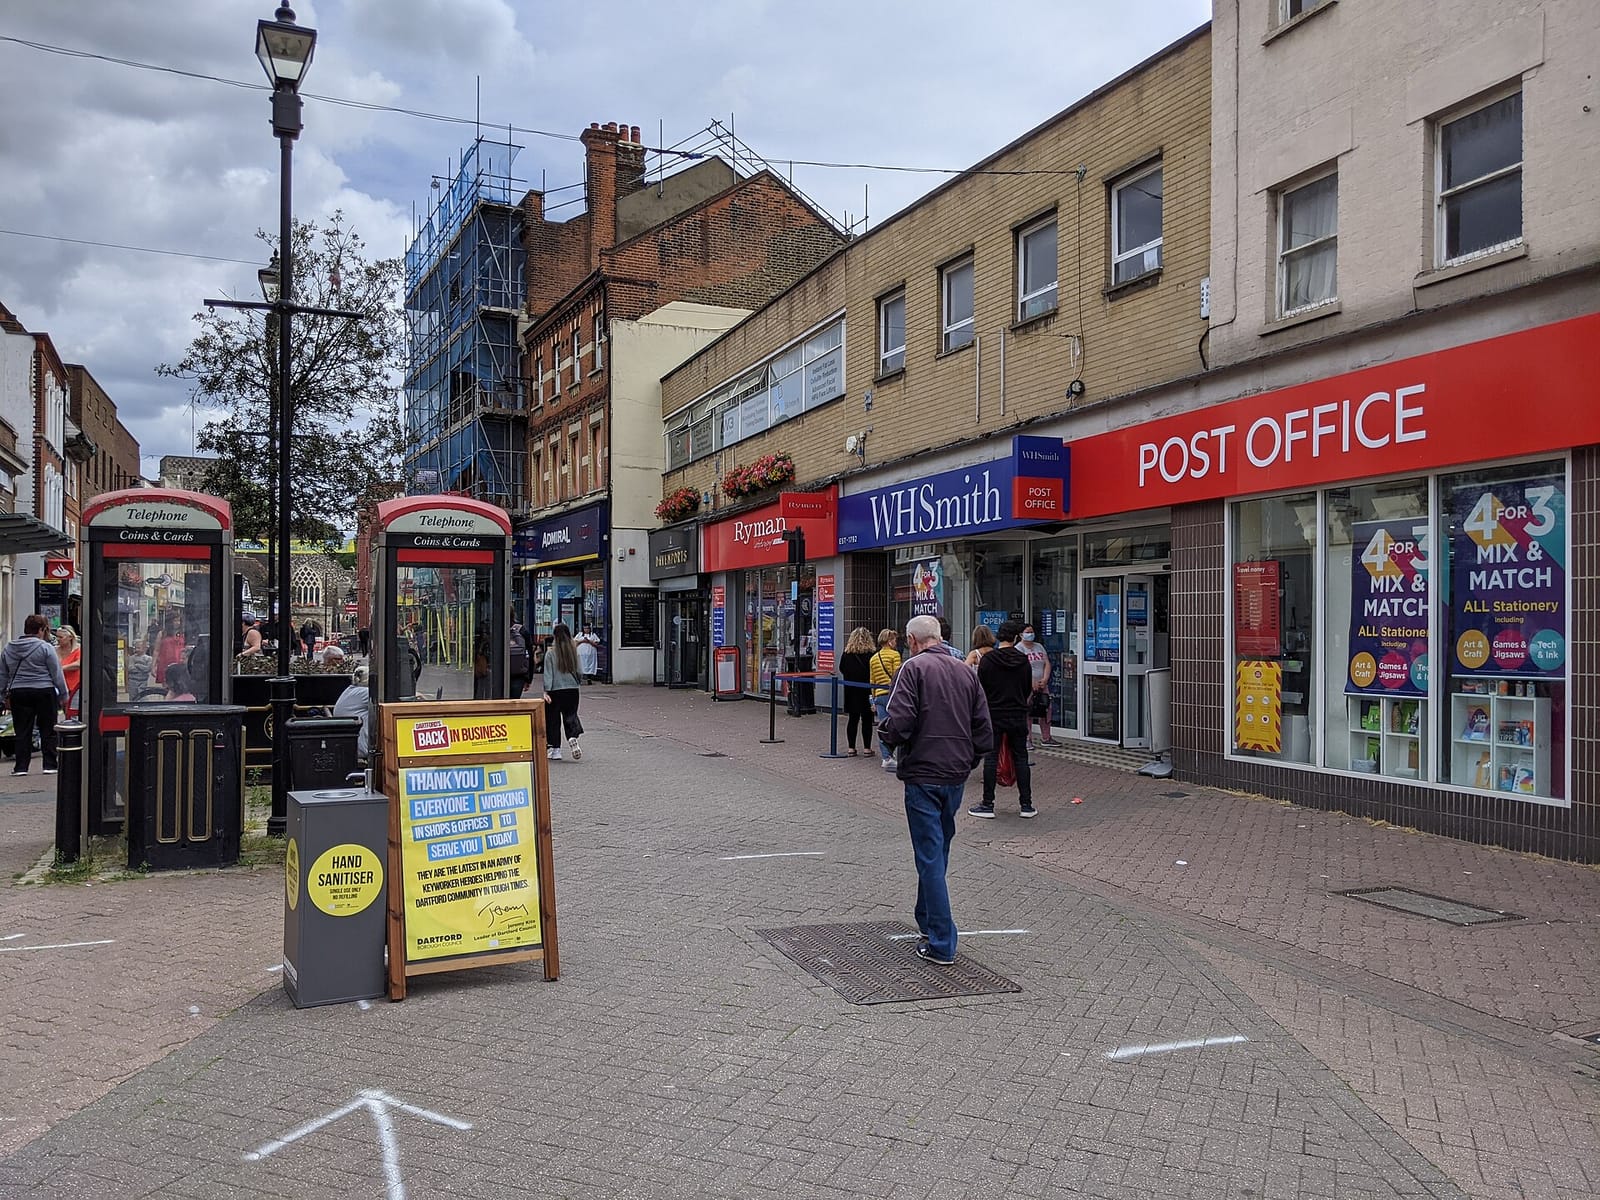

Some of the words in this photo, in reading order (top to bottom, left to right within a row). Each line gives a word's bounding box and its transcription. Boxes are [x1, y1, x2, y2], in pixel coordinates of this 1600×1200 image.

[1139, 424, 1236, 488] POST
[1245, 383, 1427, 468] OFFICE
[1022, 450, 1060, 462] WHSmith
[1028, 488, 1052, 497] POST
[869, 470, 1003, 542] WHSmith
[1024, 498, 1056, 510] OFFICE
[126, 508, 189, 524] Telephone
[1463, 492, 1497, 540] 4
[1496, 505, 1527, 521] FOR
[1523, 486, 1556, 536] 3
[419, 515, 474, 529] Telephone
[120, 530, 149, 542] Coins
[150, 531, 162, 542] &
[163, 530, 194, 542] Cards
[542, 526, 571, 548] ADMIRAL
[733, 517, 788, 544] Ryman
[414, 536, 440, 546] Coins
[442, 537, 451, 546] &
[453, 537, 480, 547] Cards
[1360, 528, 1388, 572] 4
[1387, 542, 1414, 554] FOR
[1476, 543, 1518, 565] MIX
[1526, 540, 1543, 561] &
[912, 564, 922, 588] 4
[928, 562, 938, 588] 3
[1468, 567, 1552, 590] MATCH
[1370, 574, 1404, 594] MIX
[1411, 574, 1426, 592] &
[916, 590, 928, 601] MIX
[930, 589, 935, 600] &
[914, 602, 938, 615] MATCH
[1464, 600, 1490, 613] ALL
[1493, 600, 1558, 612] Stationery
[1494, 616, 1524, 624] Including
[1358, 625, 1378, 637] ALL
[1464, 640, 1476, 648] Art
[1492, 640, 1519, 648] Games
[1537, 640, 1556, 648] Tech
[1464, 650, 1482, 658] Craft
[1494, 650, 1525, 660] Jigsaws
[1378, 662, 1402, 670] Games
[1354, 670, 1370, 678] Craft
[1379, 672, 1406, 680] Jigsaws
[418, 730, 446, 747] BACK
[449, 729, 460, 743] IN
[461, 724, 508, 742] BUSINESS
[409, 772, 453, 791] THANK
[453, 770, 478, 790] YOU
[491, 774, 502, 785] TO
[414, 796, 470, 818] EVERYONE
[481, 790, 525, 810] WORKING
[415, 826, 425, 839] IN
[425, 822, 450, 837] SHOPS
[452, 822, 458, 832] &
[458, 818, 489, 832] OFFICES
[501, 814, 512, 825] TO
[431, 844, 460, 858] SERVE
[461, 842, 478, 854] YOU
[487, 832, 513, 845] TODAY
[332, 856, 362, 869] HAND
[417, 870, 433, 880] THEY
[434, 868, 446, 878] ARE
[446, 866, 458, 876] THE
[458, 862, 479, 874] LATEST
[480, 861, 486, 870] IN
[487, 860, 496, 869] AN
[496, 856, 514, 866] ARMY
[514, 854, 522, 863] OF
[318, 870, 374, 886] SANITISER
[422, 879, 460, 894] KEYWORKER
[460, 875, 483, 887] HEROES
[484, 870, 508, 882] HELPING
[508, 868, 520, 877] THE
[416, 894, 446, 908] DARTFORD
[447, 888, 482, 902] COMMUNITY
[484, 886, 490, 896] IN
[491, 882, 510, 894] TOUGH
[417, 934, 462, 944] DARTFORD
